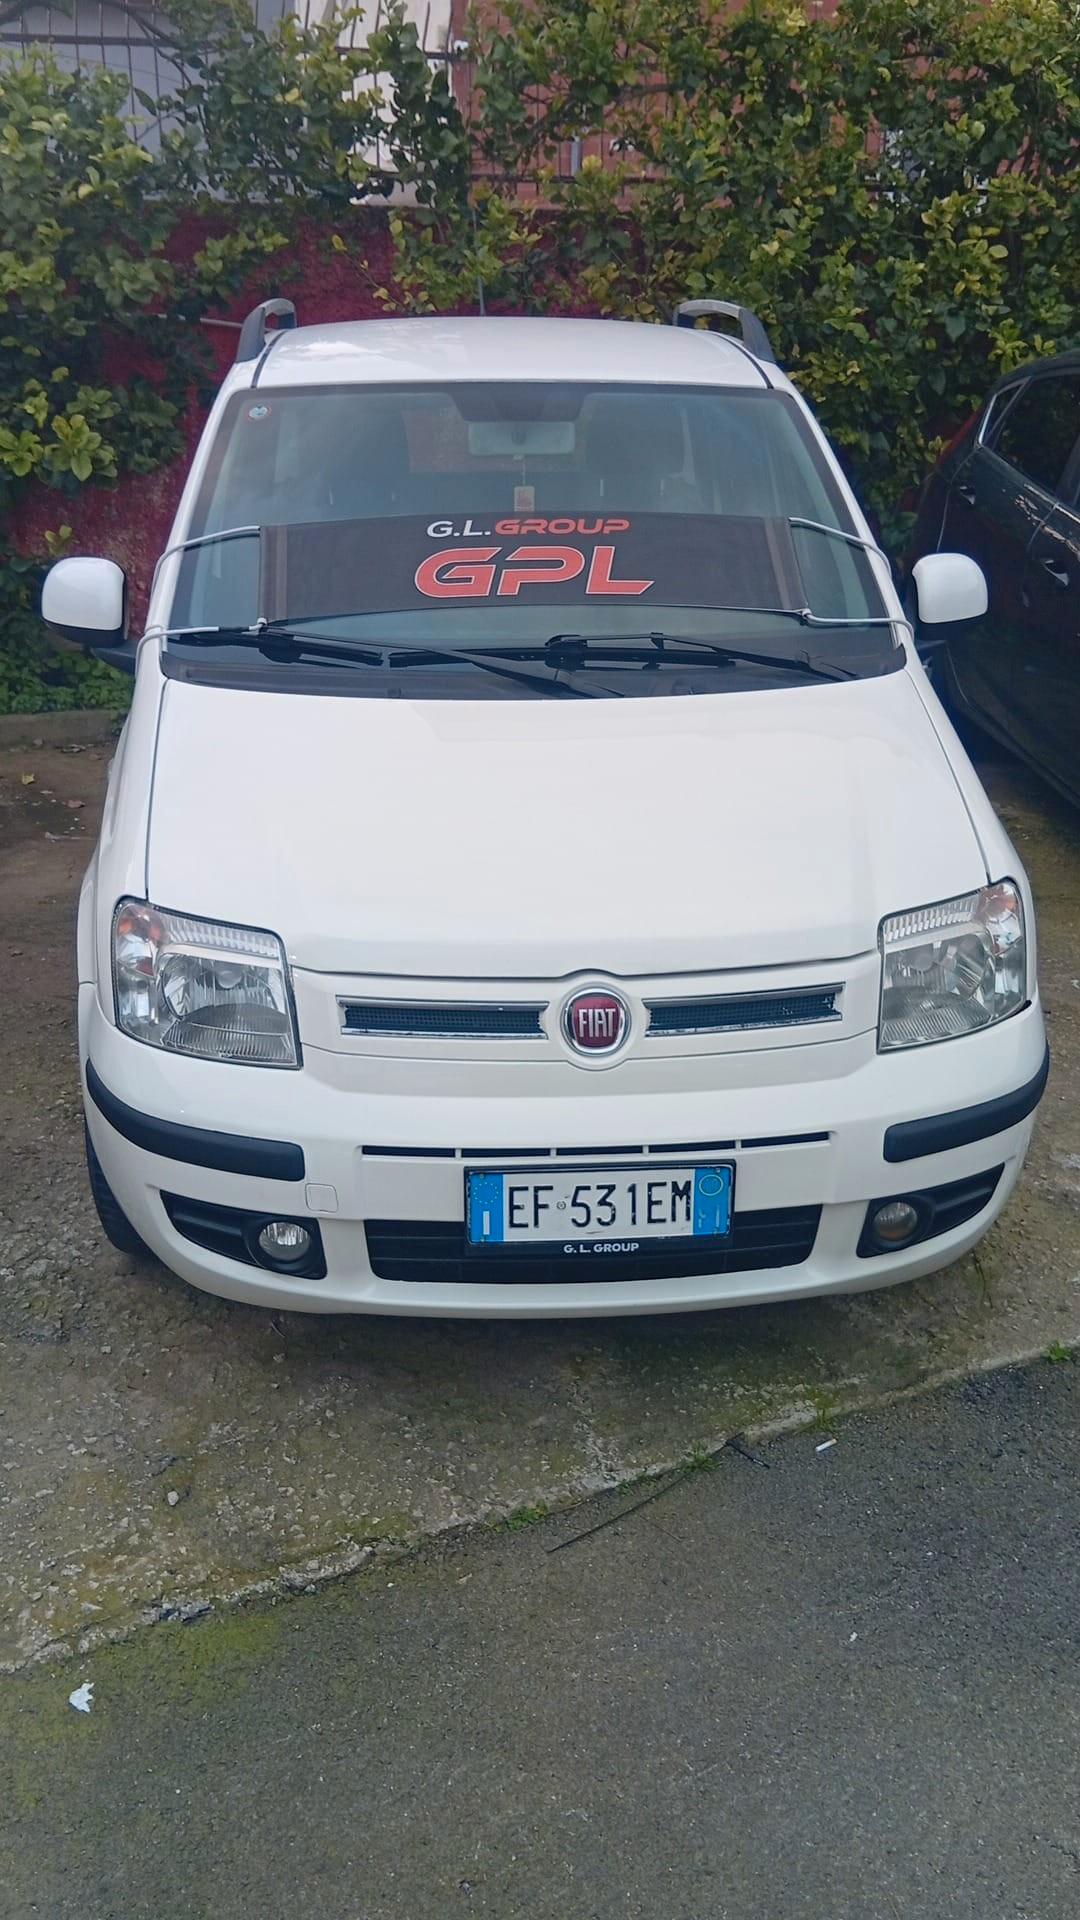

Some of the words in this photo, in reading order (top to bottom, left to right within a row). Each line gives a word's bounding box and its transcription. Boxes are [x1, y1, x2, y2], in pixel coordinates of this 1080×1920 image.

[414, 545, 655, 598] GPL
[578, 1008, 616, 1038] FIAT
[508, 1185, 553, 1228] EF
[570, 1180, 692, 1228] 531EM
[593, 1242, 640, 1253] GROUP
